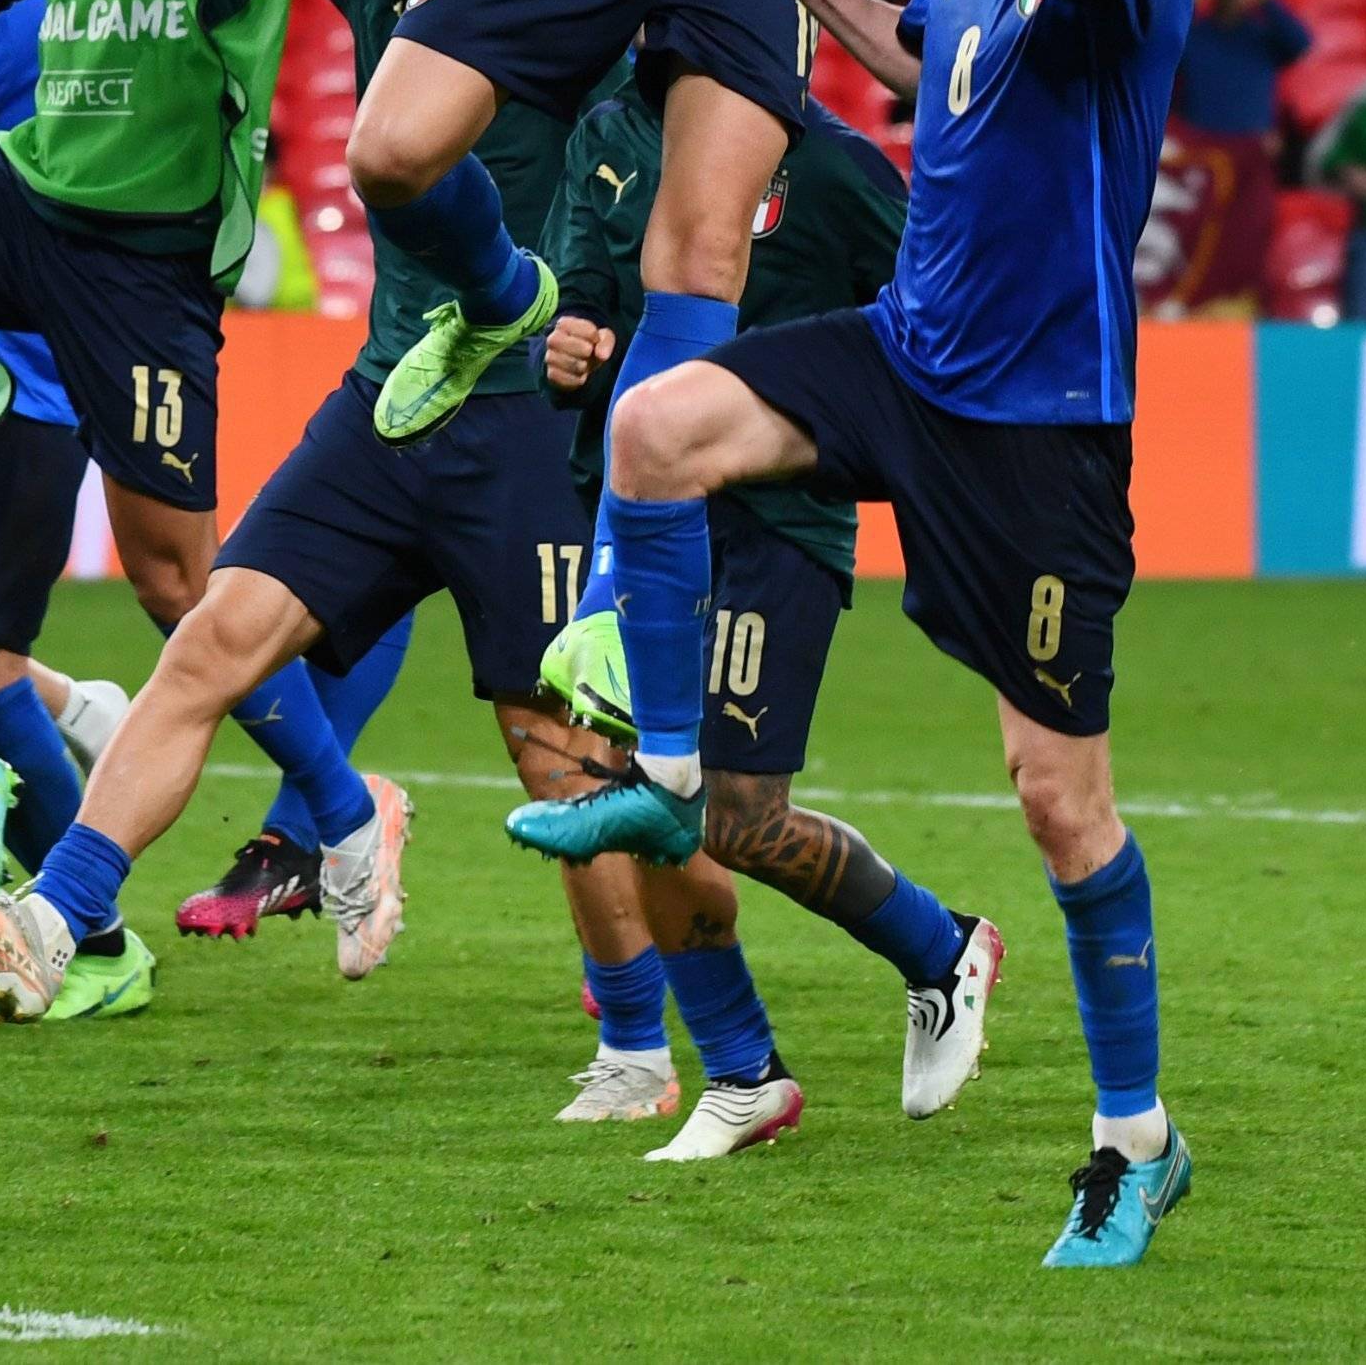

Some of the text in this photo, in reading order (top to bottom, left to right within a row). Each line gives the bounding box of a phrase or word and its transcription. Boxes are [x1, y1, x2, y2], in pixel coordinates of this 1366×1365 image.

[45, 78, 134, 107] RESPECT
[948, 24, 982, 117] 8
[132, 365, 183, 448] 13
[537, 543, 583, 623] 17
[1027, 574, 1065, 662] 8
[708, 609, 766, 697] 10
